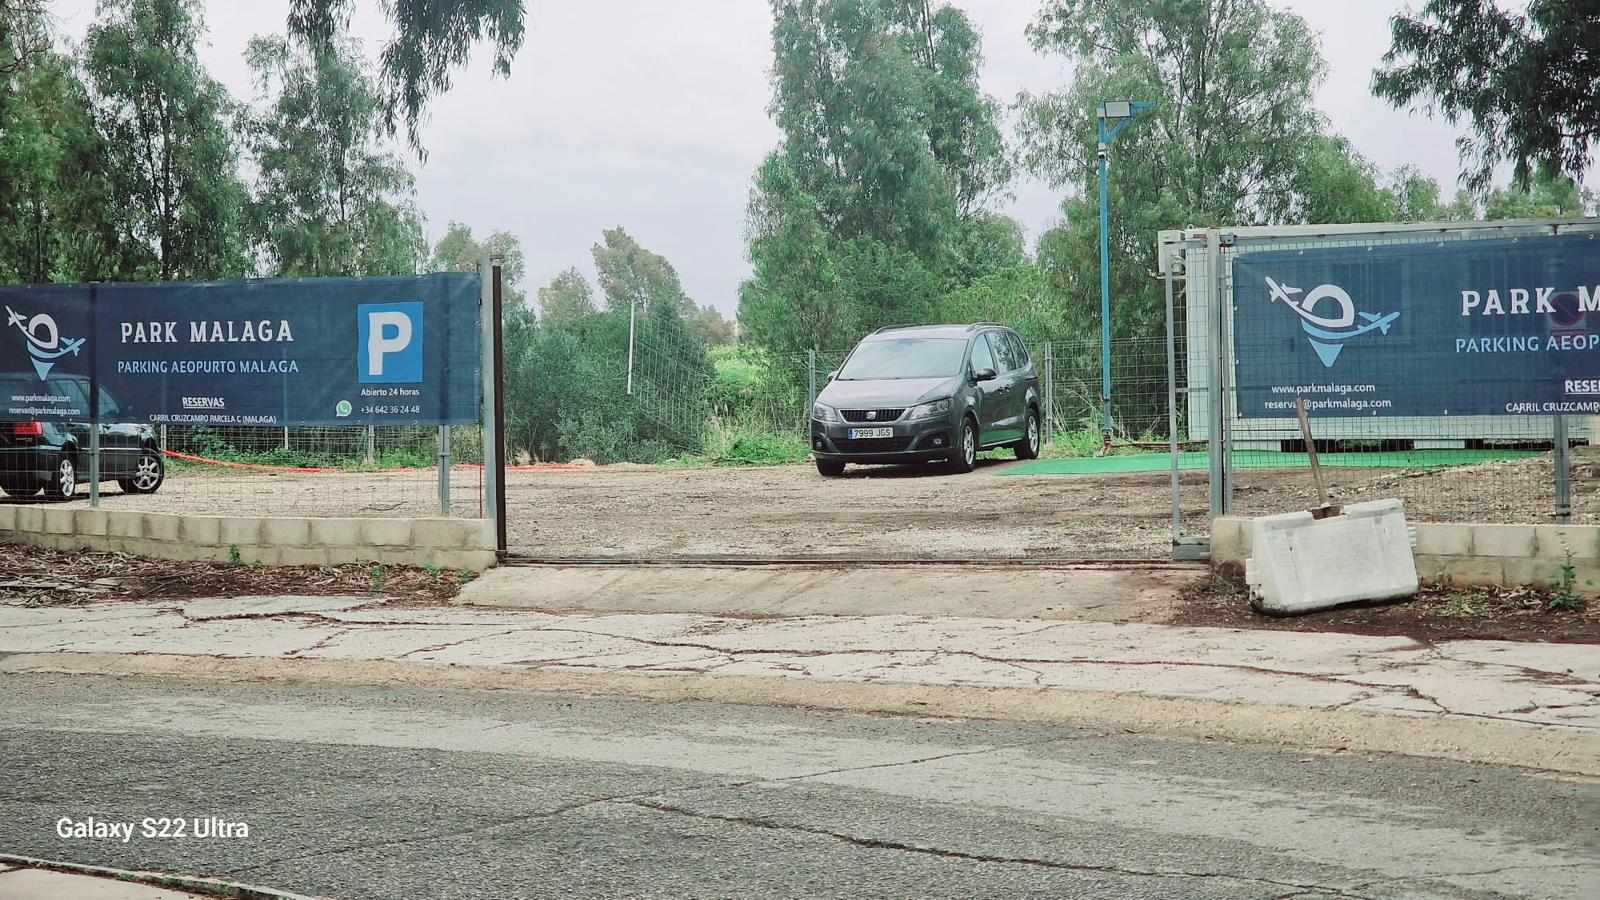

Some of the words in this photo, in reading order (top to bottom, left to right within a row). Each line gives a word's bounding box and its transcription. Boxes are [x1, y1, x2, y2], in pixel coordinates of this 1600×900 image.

[1461, 287, 1556, 316] PARK
[120, 321, 178, 343] PARK
[190, 319, 294, 343] MALAGA
[368, 311, 412, 375] P
[1456, 336, 1539, 352] PARKING
[1546, 334, 1600, 350] AEOP
[117, 360, 168, 373] PARKING
[171, 359, 236, 373] AEOPURTO
[240, 359, 300, 373] MALAGA
[361, 388, 387, 396] Abierto
[388, 388, 398, 396] 24
[399, 387, 420, 396] horas
[1271, 382, 1376, 396] www.parkmalaga.com
[1565, 379, 1600, 393] RESE
[182, 397, 225, 409] RESERVAS
[361, 405, 373, 414] +34
[375, 405, 389, 414] 642
[1264, 399, 1392, 410] reserva@parkmalaga.com
[1505, 403, 1541, 413] CARRIL
[854, 429, 874, 438] 7999
